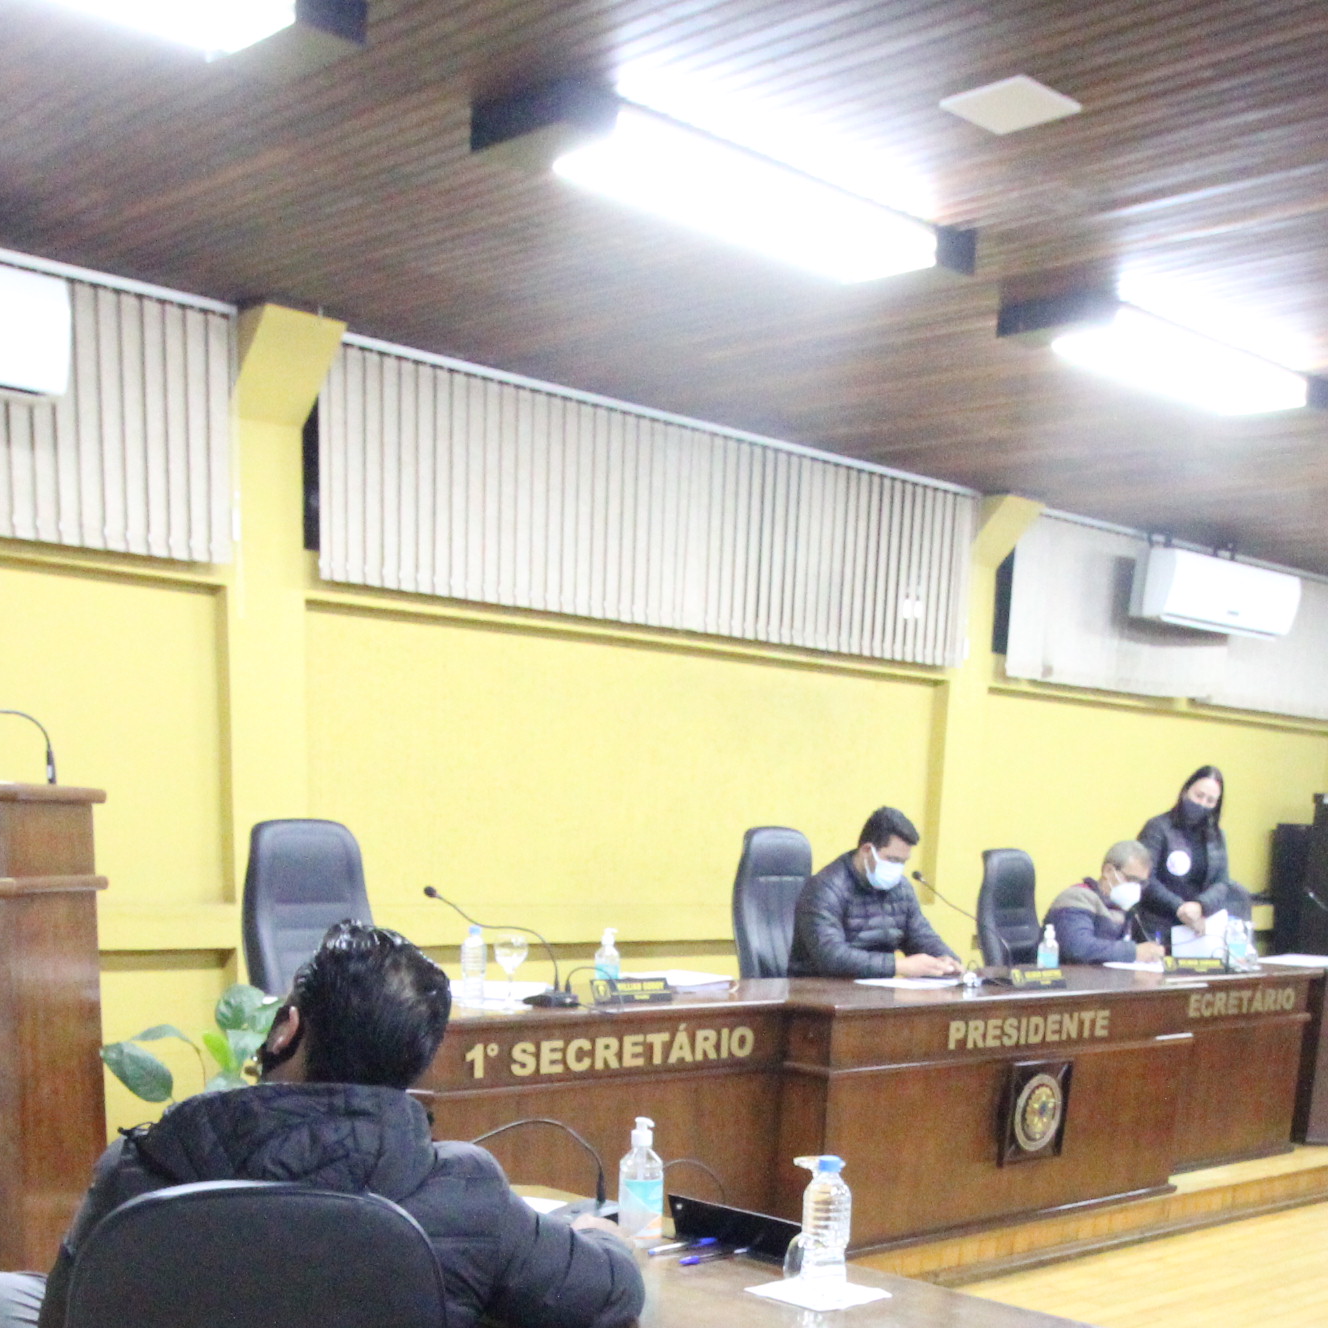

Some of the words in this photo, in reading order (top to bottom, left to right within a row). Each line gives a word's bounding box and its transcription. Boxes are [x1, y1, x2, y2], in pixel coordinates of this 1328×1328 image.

[1188, 985, 1295, 1018] ECRETÁRIO
[510, 1023, 755, 1077] SECRETÁRIO
[947, 1010, 1110, 1050] PRESIDENTE
